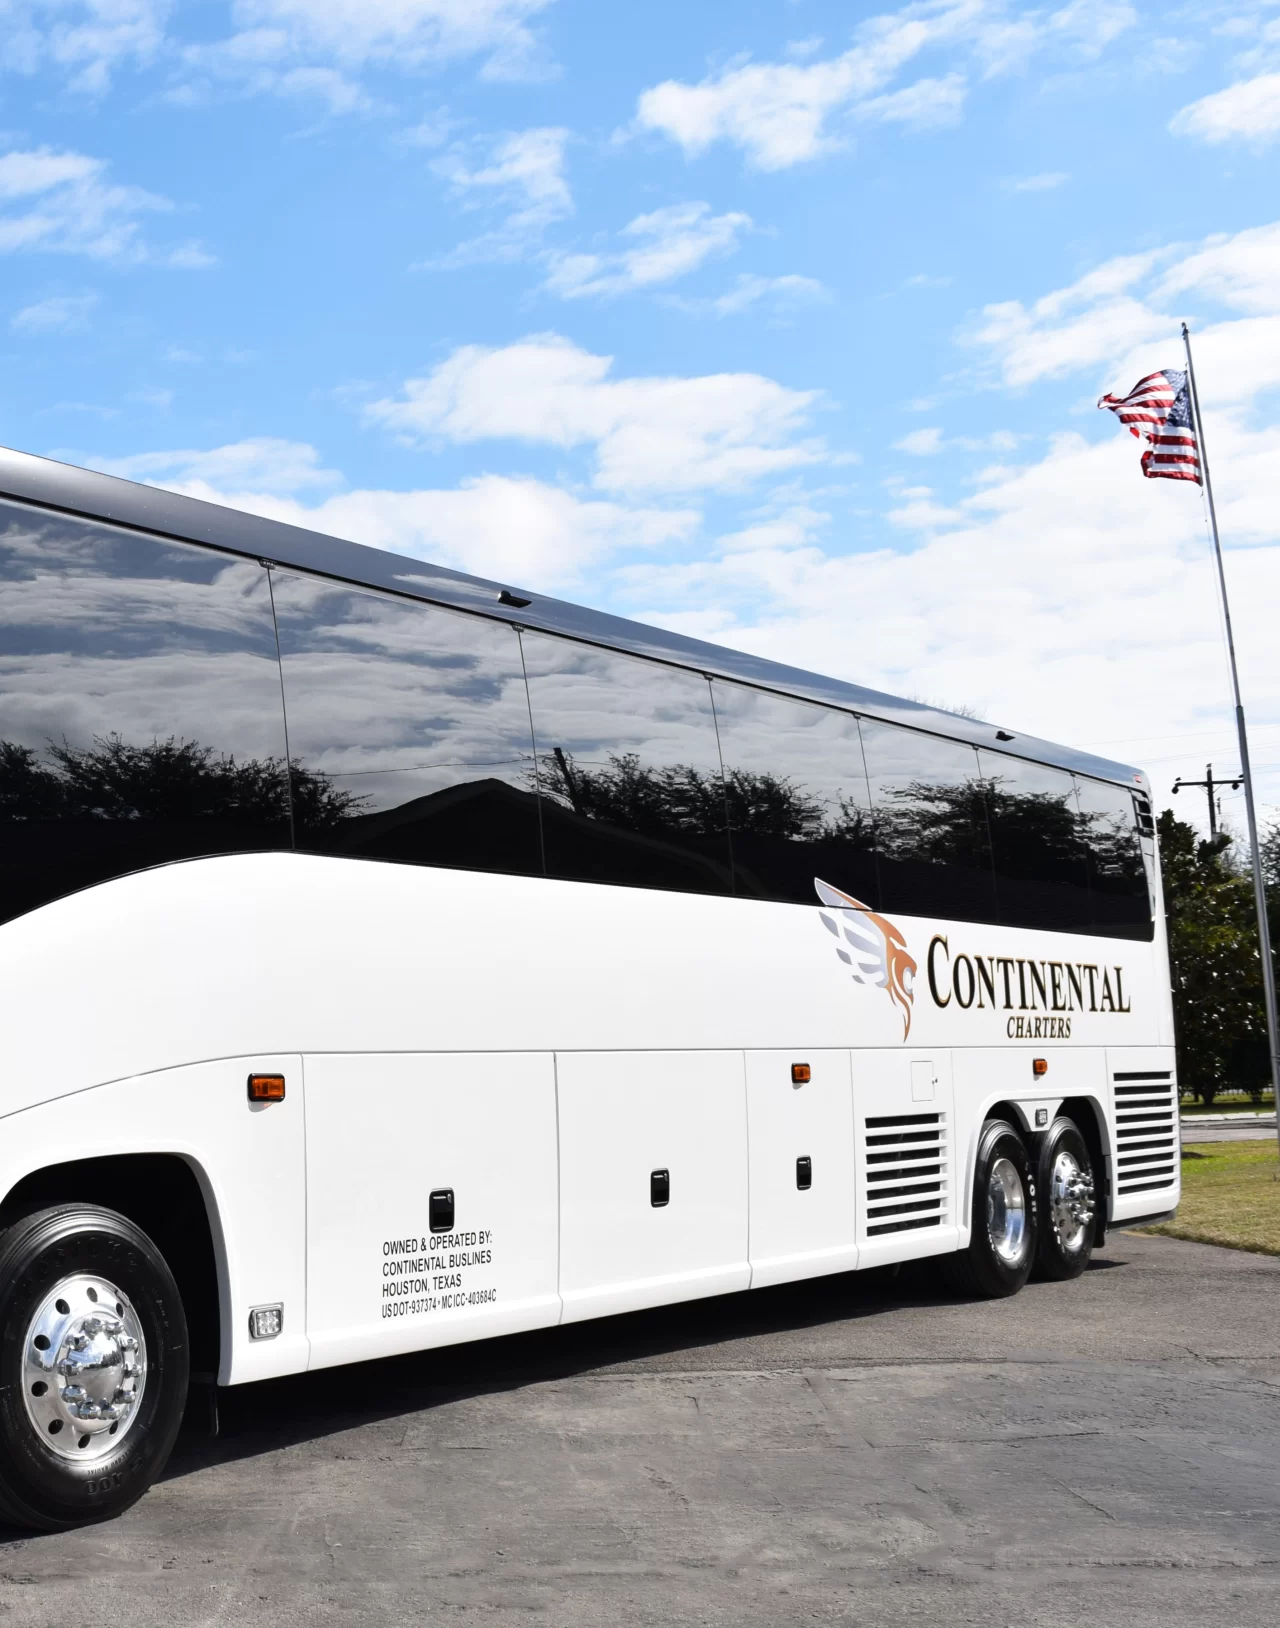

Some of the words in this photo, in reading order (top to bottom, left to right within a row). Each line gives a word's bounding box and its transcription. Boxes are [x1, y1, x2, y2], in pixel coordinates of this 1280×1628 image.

[927, 933, 1131, 1013] CONTINENTAL
[1006, 1016, 1071, 1039] CHARTERS
[382, 1238, 418, 1256] OWNED
[420, 1237, 427, 1251] &
[429, 1232, 477, 1250] OPERATED
[479, 1230, 492, 1245] BY:
[382, 1256, 446, 1276] CONTINENTAL
[449, 1250, 492, 1268] BUSLINES
[382, 1278, 430, 1297] HOUSTON,
[433, 1273, 462, 1291] TEXAS
